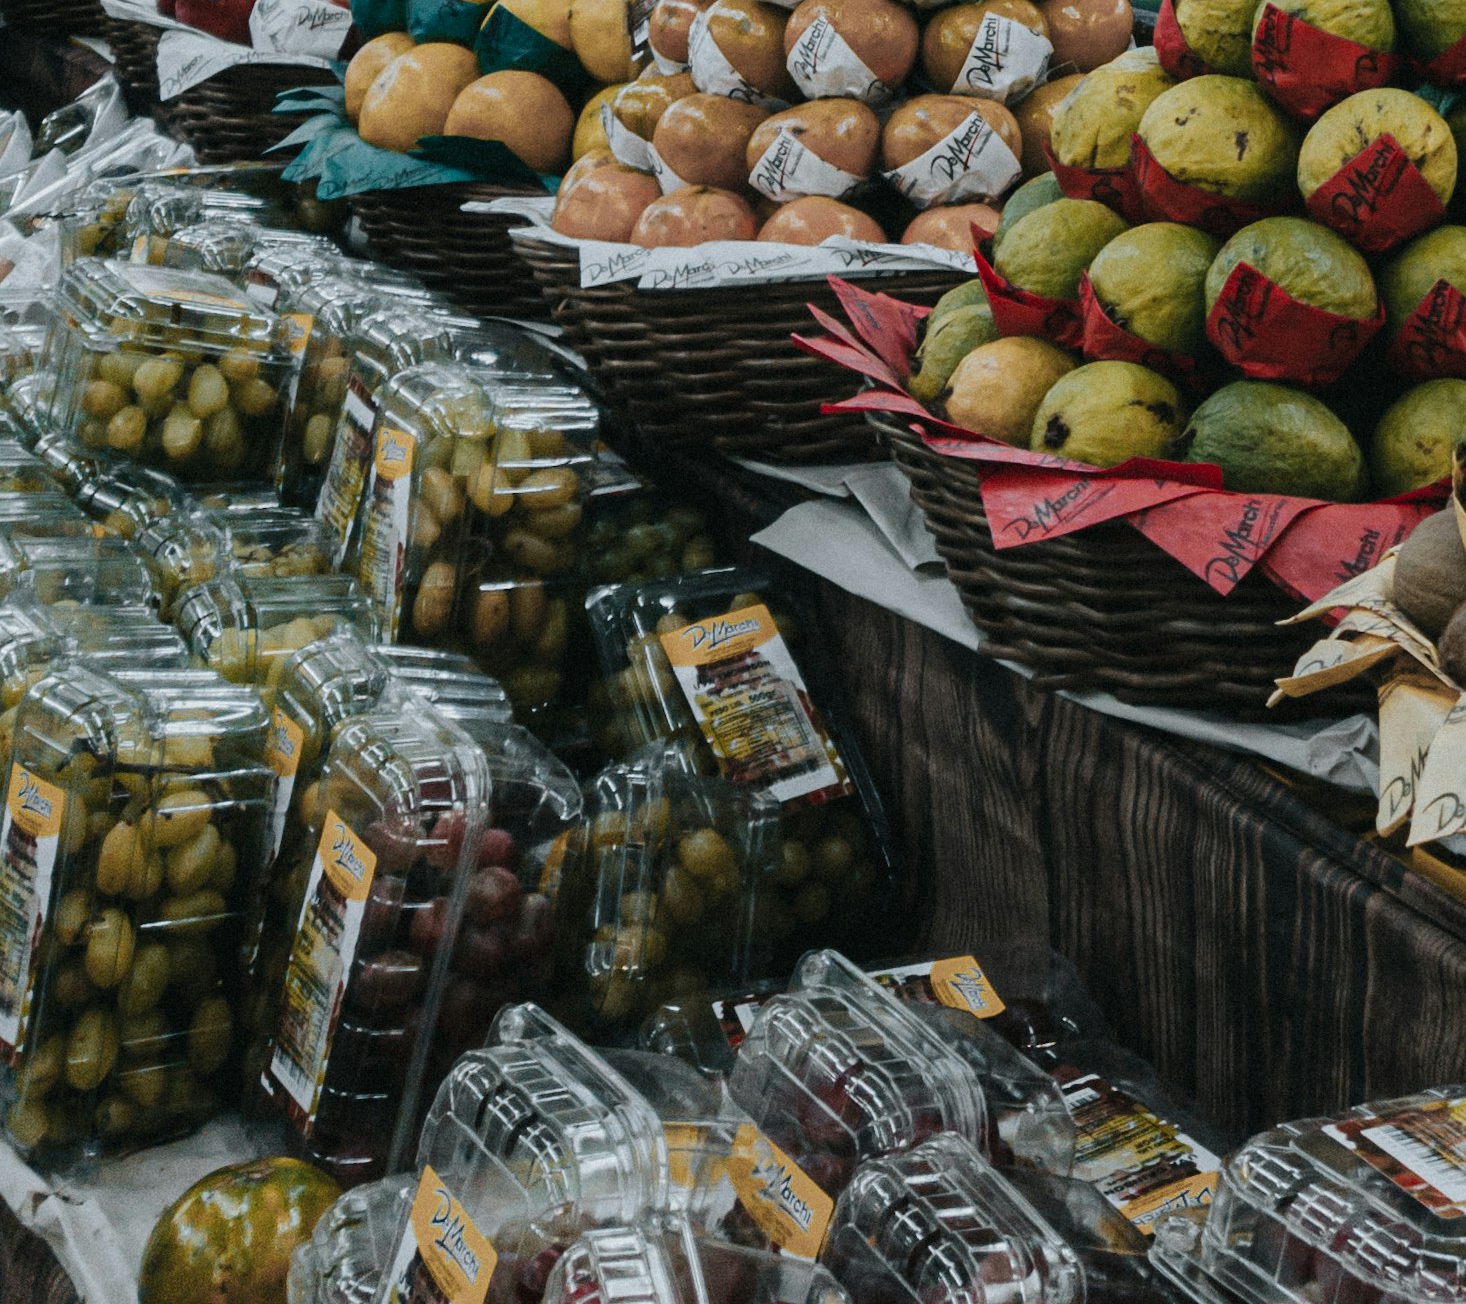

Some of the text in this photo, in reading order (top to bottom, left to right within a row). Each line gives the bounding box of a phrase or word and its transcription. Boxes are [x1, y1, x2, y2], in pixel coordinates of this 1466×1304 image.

[793, 18, 827, 81] DeMarchi
[966, 17, 1000, 86] DeMarchi
[756, 134, 792, 194] DeMarchi
[930, 114, 983, 181] DeMarchi
[1330, 143, 1395, 220] DeMarchi
[1015, 479, 1091, 540] DeMarchi
[1206, 499, 1262, 587] DeMarchi
[682, 618, 760, 650] DeMarchi
[432, 1188, 480, 1285] DeMarchi
